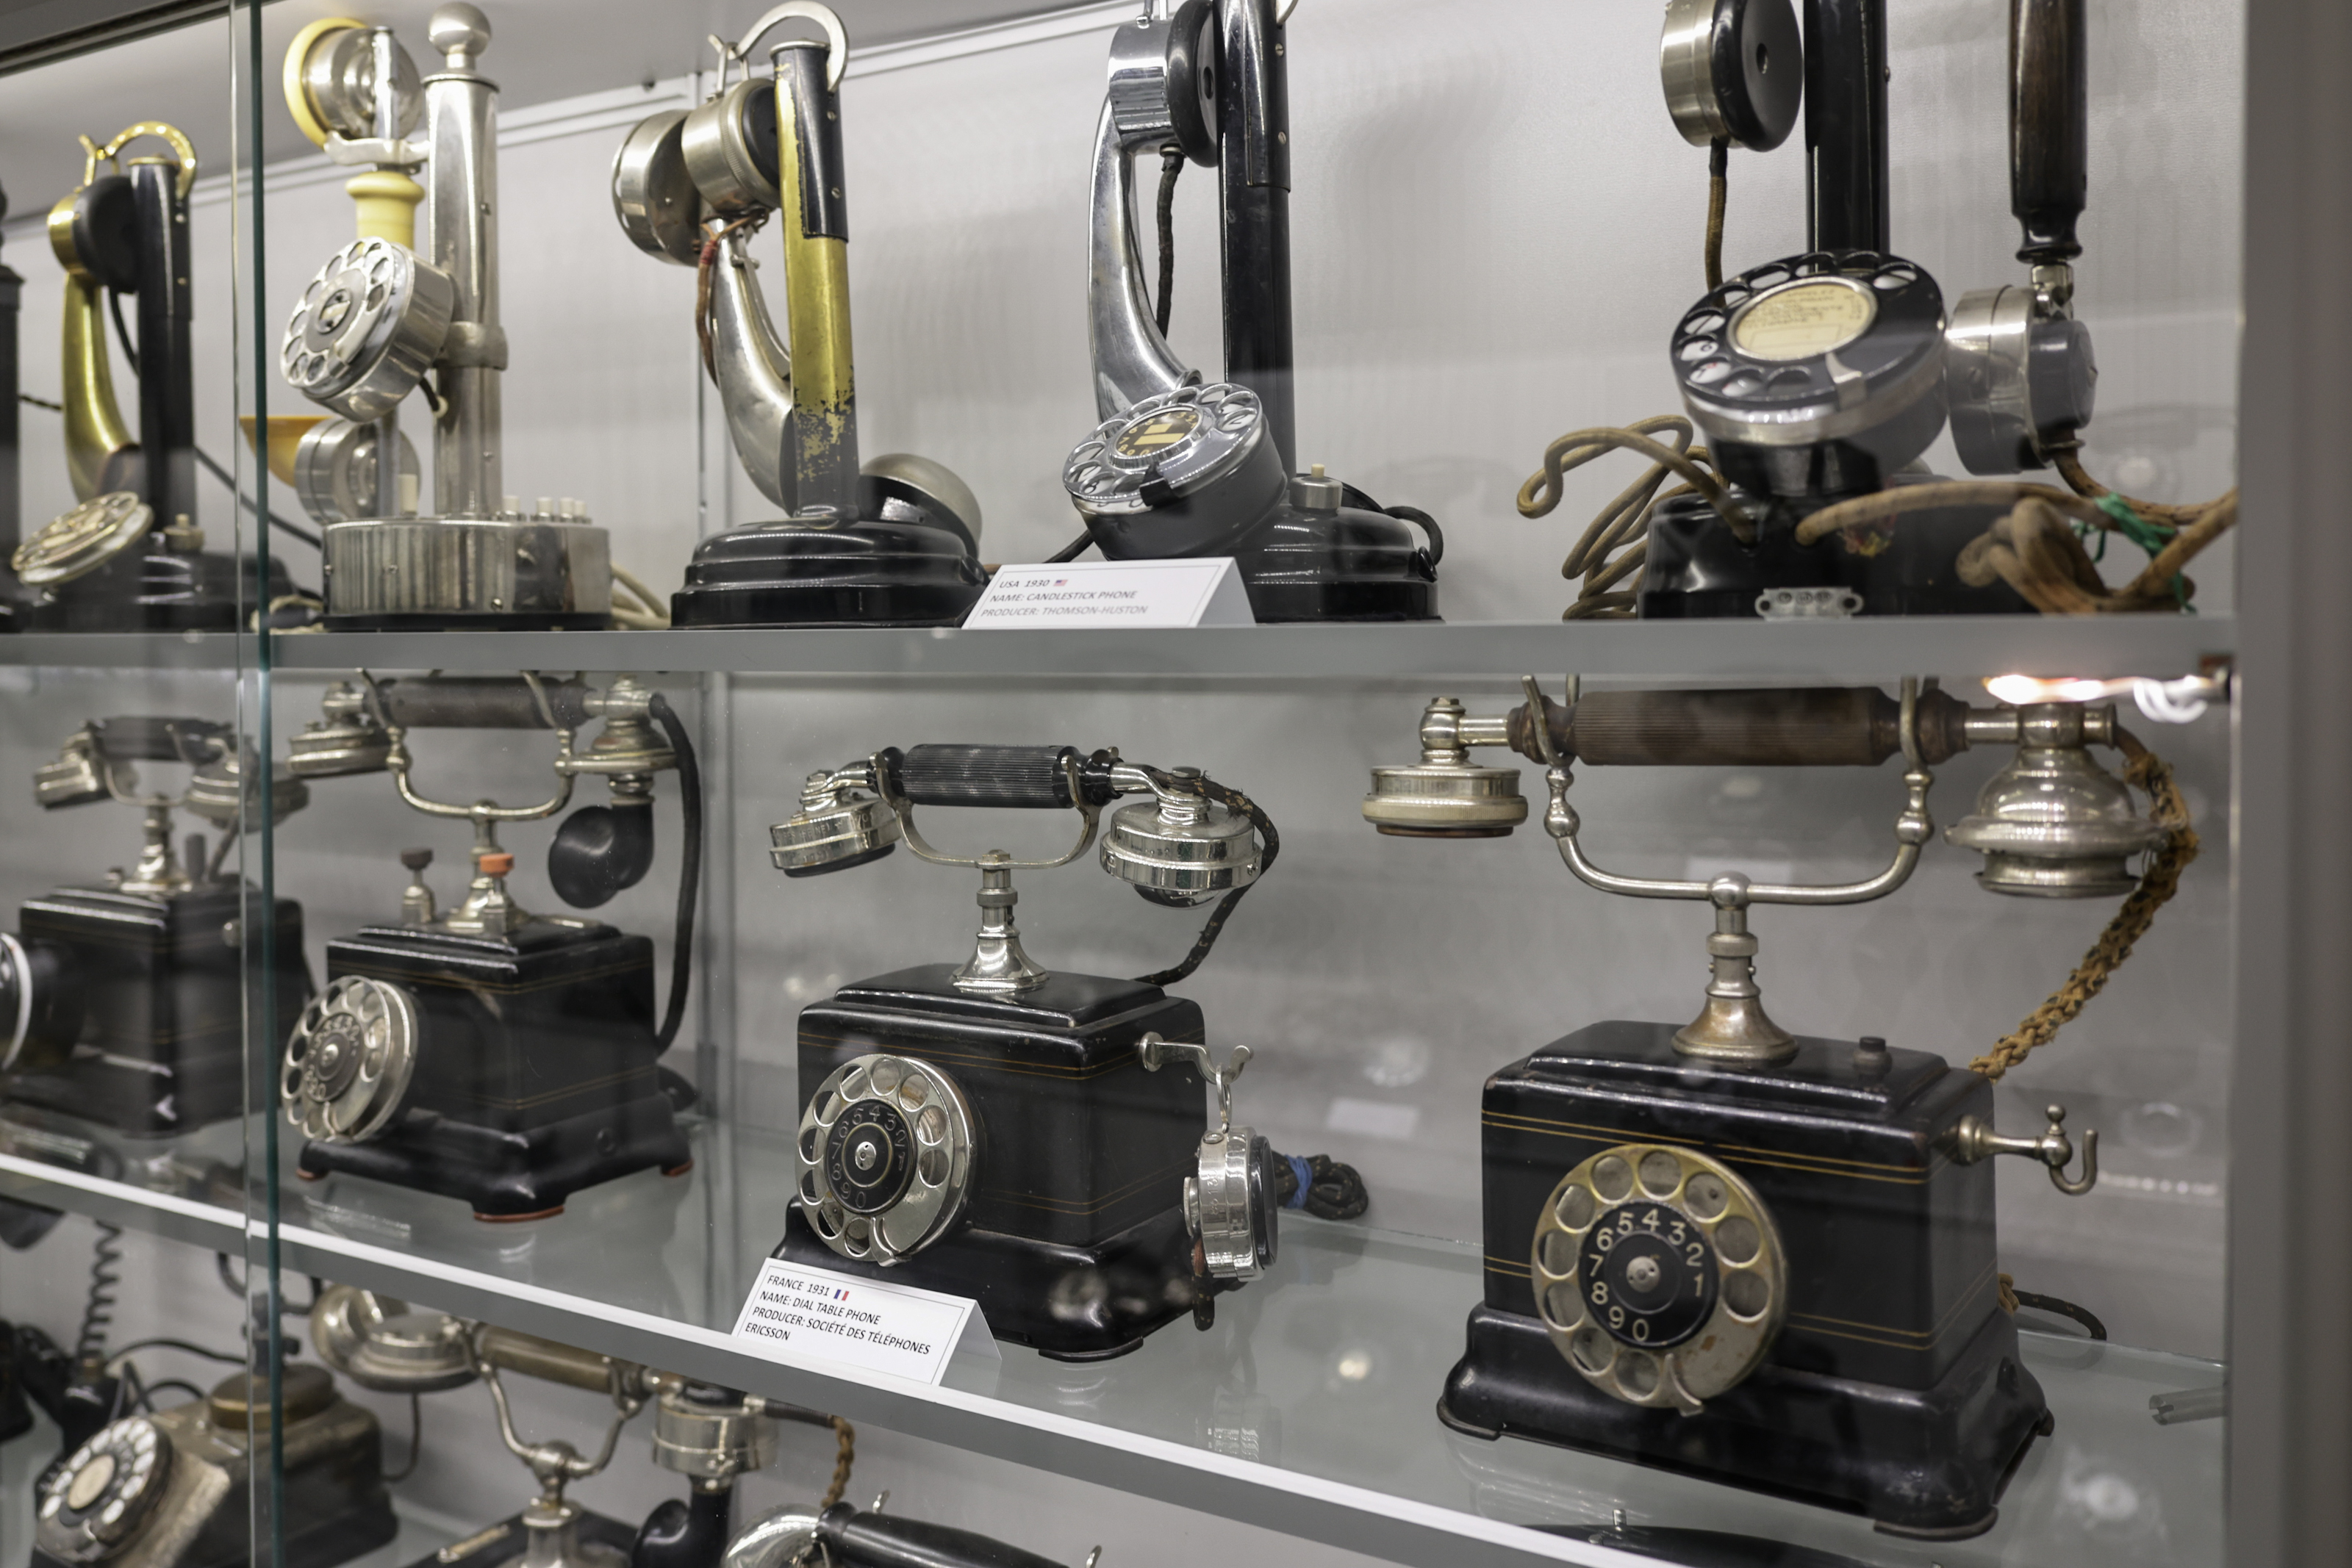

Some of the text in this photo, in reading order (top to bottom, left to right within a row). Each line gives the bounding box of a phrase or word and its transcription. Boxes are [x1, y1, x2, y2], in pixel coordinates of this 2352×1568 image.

[1000, 579, 1050, 589] USA 1930
[989, 590, 1138, 603] NAME: CANDLESTICK PHONE
[980, 605, 1149, 617] PRODUCER: THOMSON-HUSTON
[832, 1104, 906, 1209] 1 2 3 4 5 6 7 8 9 0
[767, 1275, 830, 1297] FRANCE 1931
[1588, 1209, 1704, 1342] 1 2 3 4 5 6 7 8 9 0
[759, 1291, 881, 1326] NAME: DIAL TABLE PHONE
[745, 1323, 791, 1341] ERICSSON
[752, 1306, 931, 1356] PRODUCER: SOCIÉTÉ DES TÉLÉPHONES
